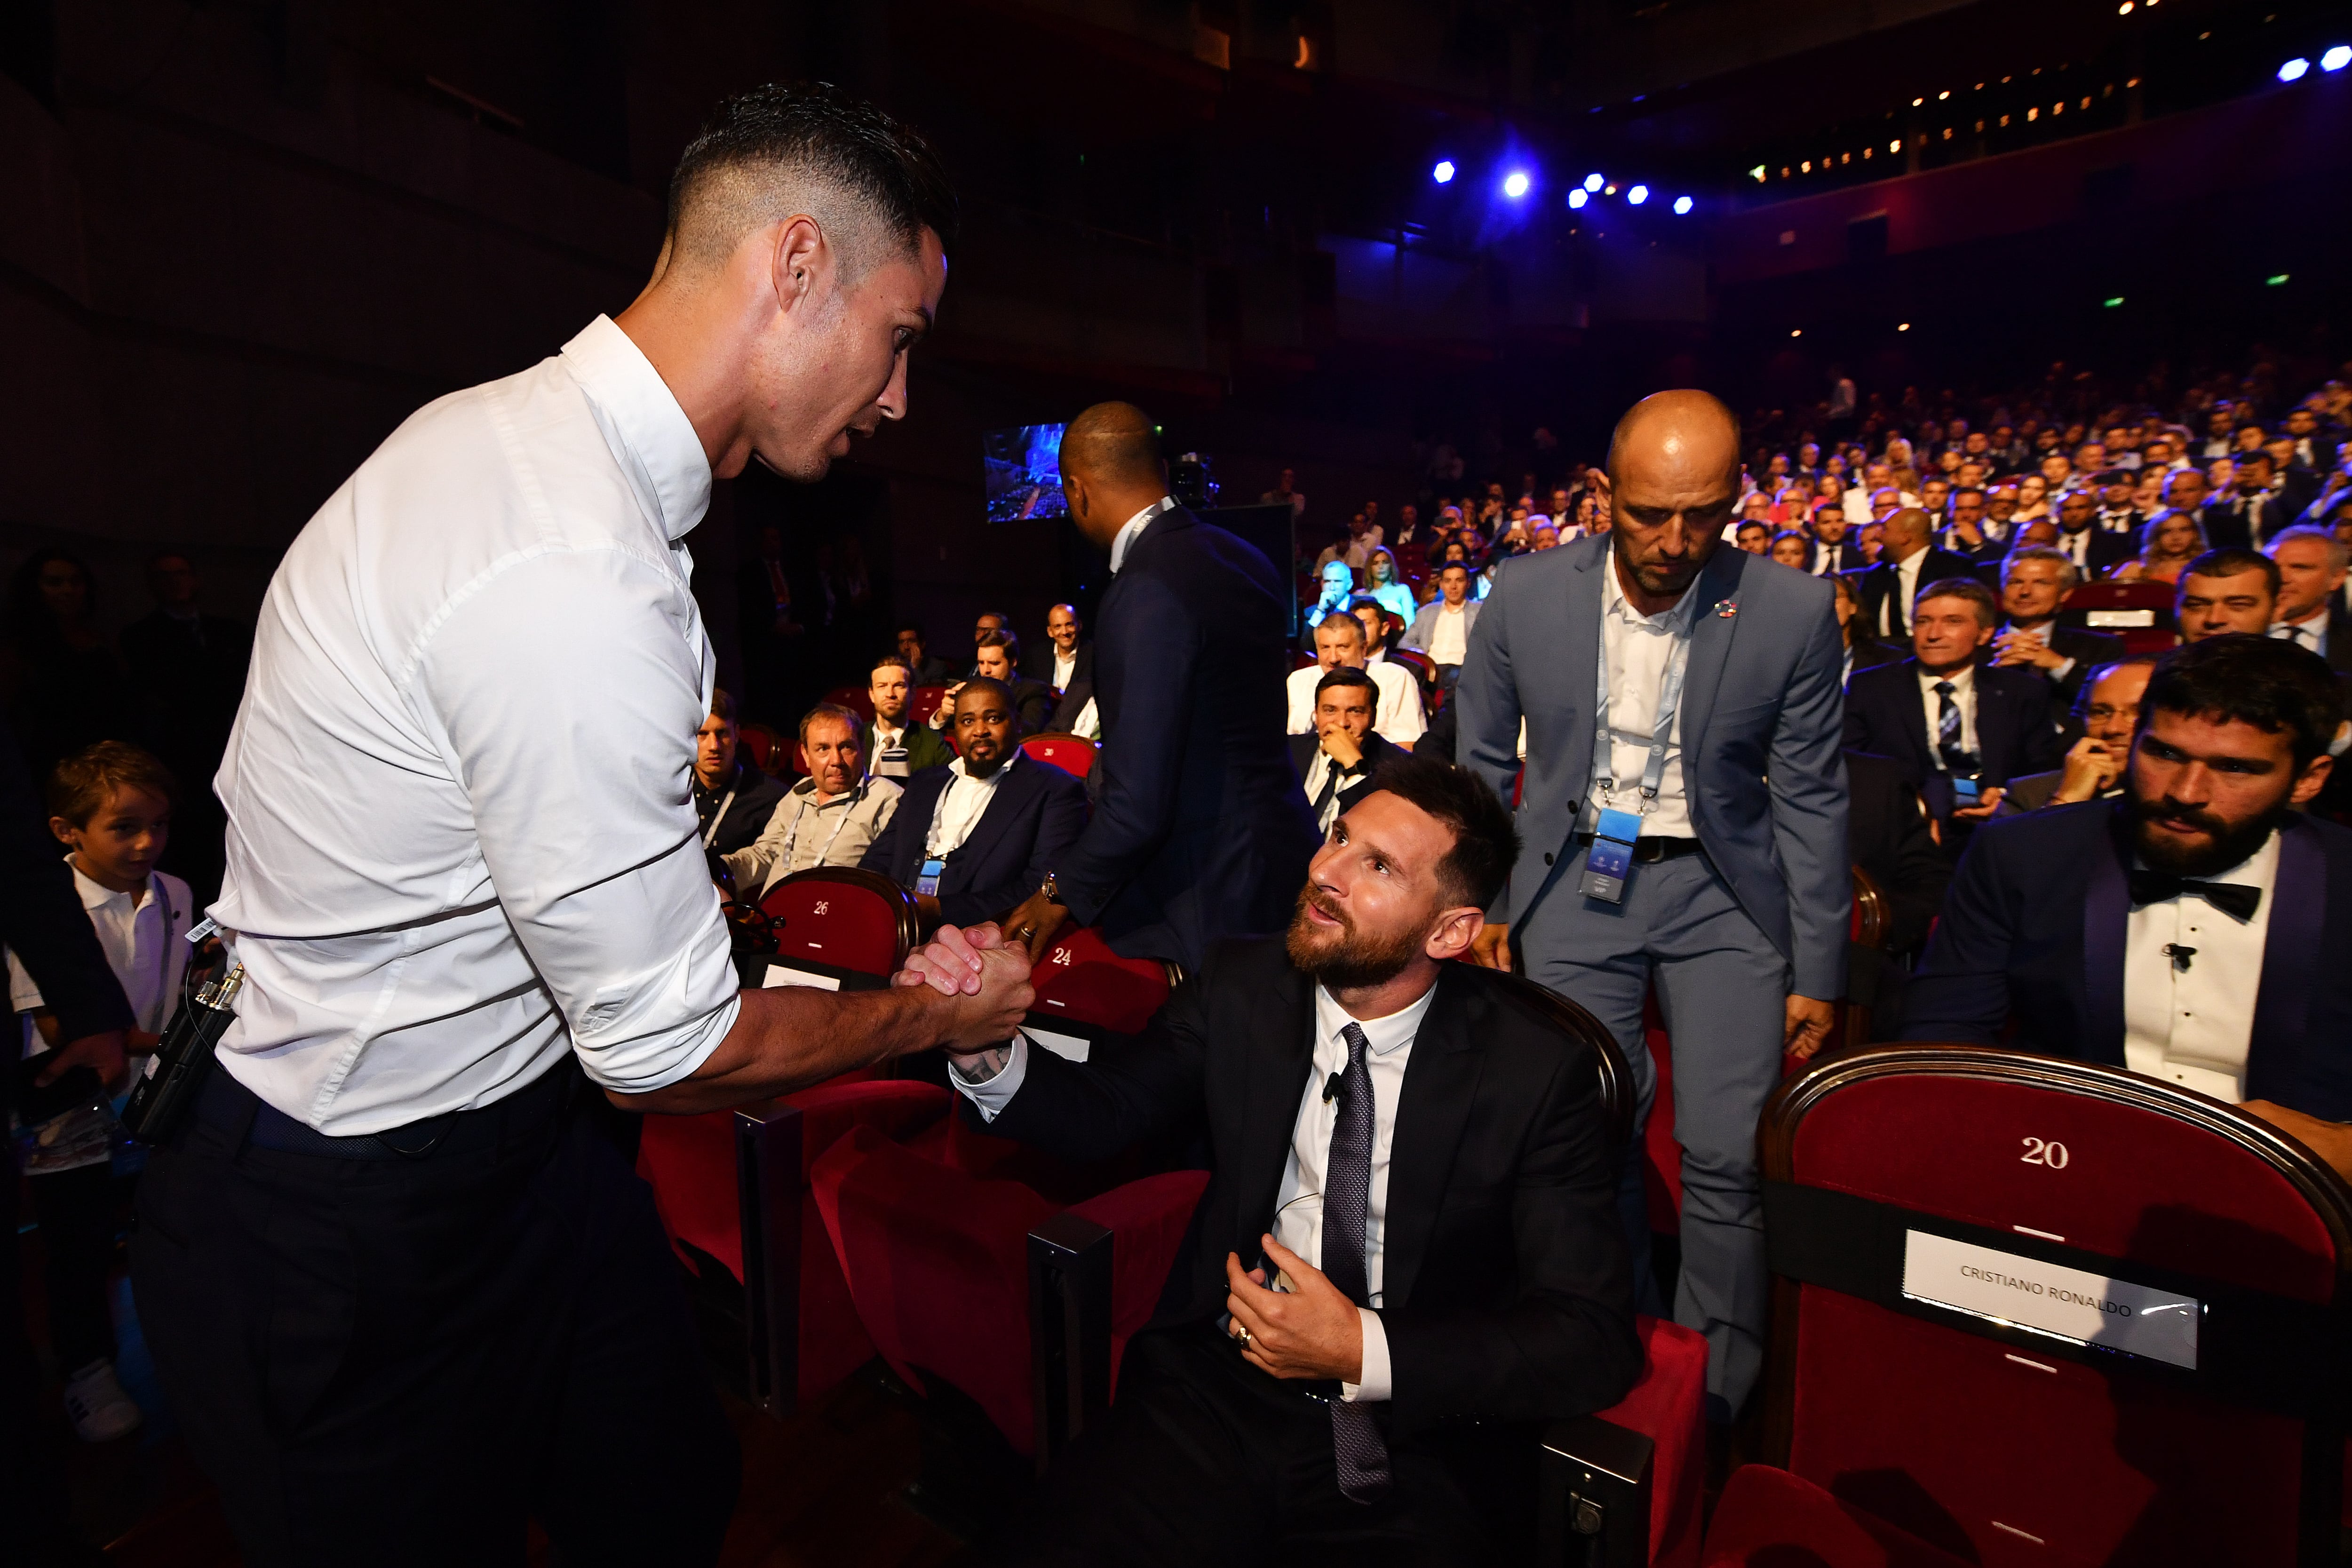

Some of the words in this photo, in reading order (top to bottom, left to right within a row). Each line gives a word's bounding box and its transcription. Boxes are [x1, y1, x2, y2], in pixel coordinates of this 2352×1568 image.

[814, 901, 829, 915] 26
[1052, 947, 1071, 965] 24
[2020, 1137, 2068, 1169] 20
[1961, 1265, 2043, 1295] CRISTIANO
[2048, 1286, 2131, 1317] RONALDO
